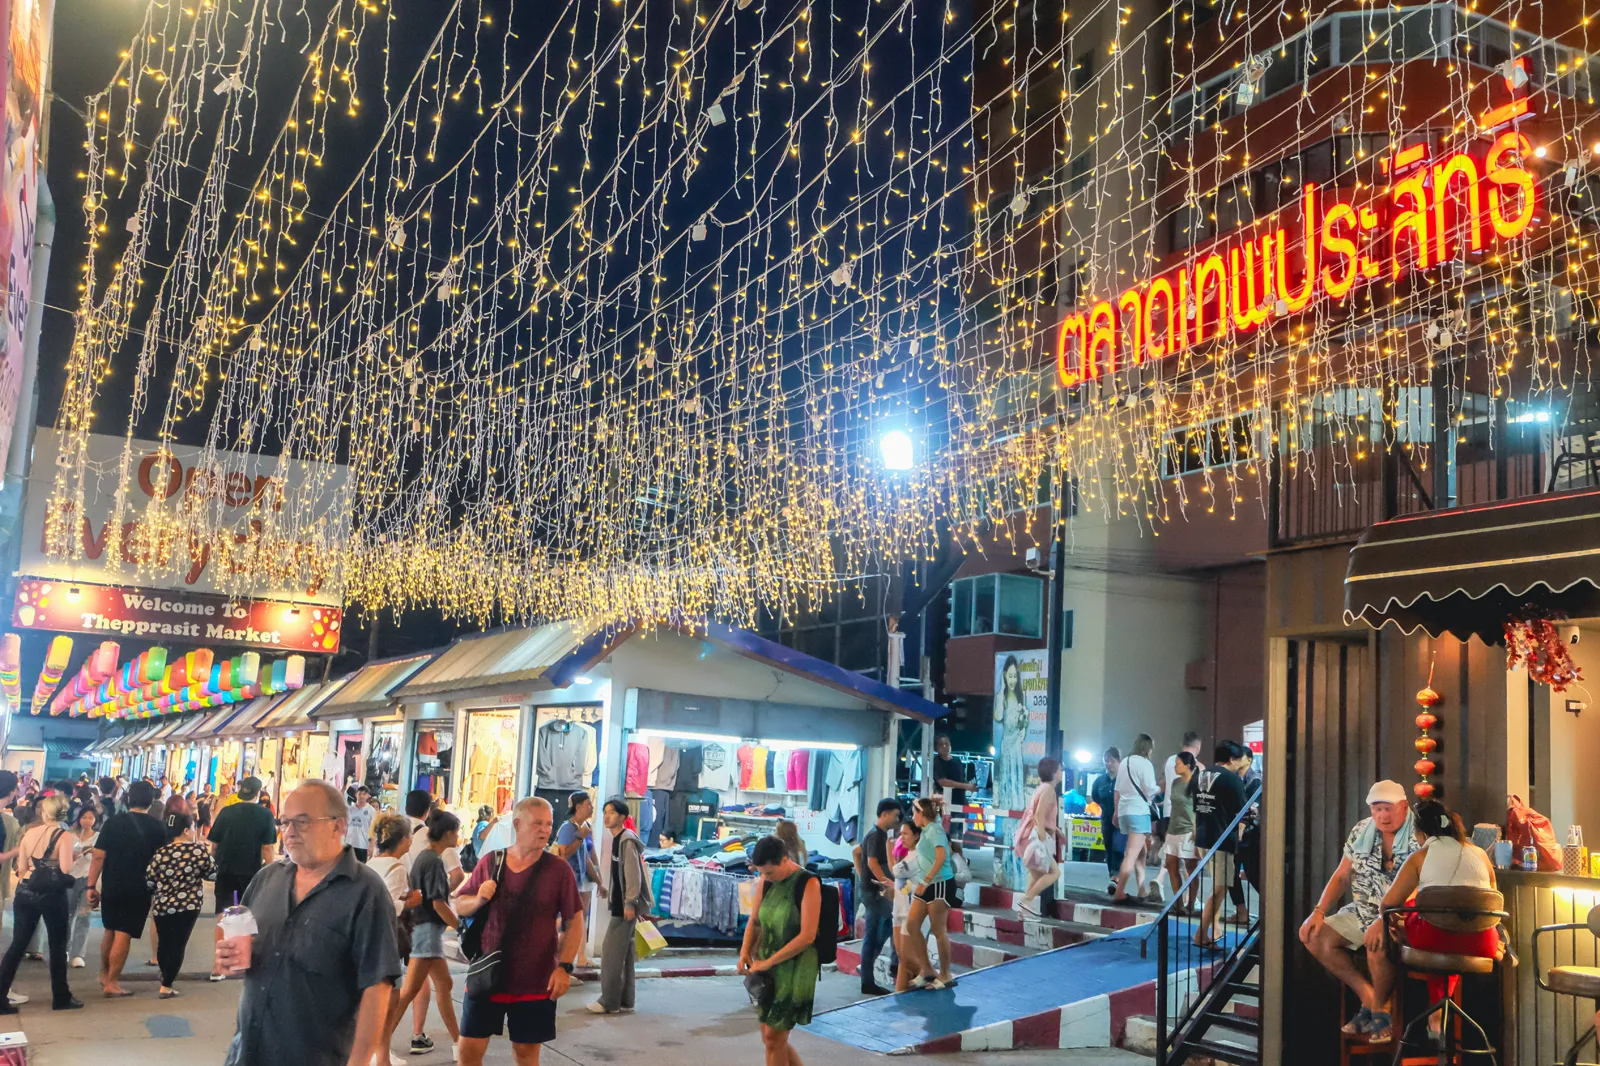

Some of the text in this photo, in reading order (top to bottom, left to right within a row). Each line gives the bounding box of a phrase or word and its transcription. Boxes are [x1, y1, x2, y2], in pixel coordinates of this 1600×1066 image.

[1057, 57, 1538, 387] ตลาดเทพประสิทธิ์
[137, 450, 282, 513] Open
[81, 613, 281, 644] Thepprasit Market
[122, 594, 247, 619] Welcome To
